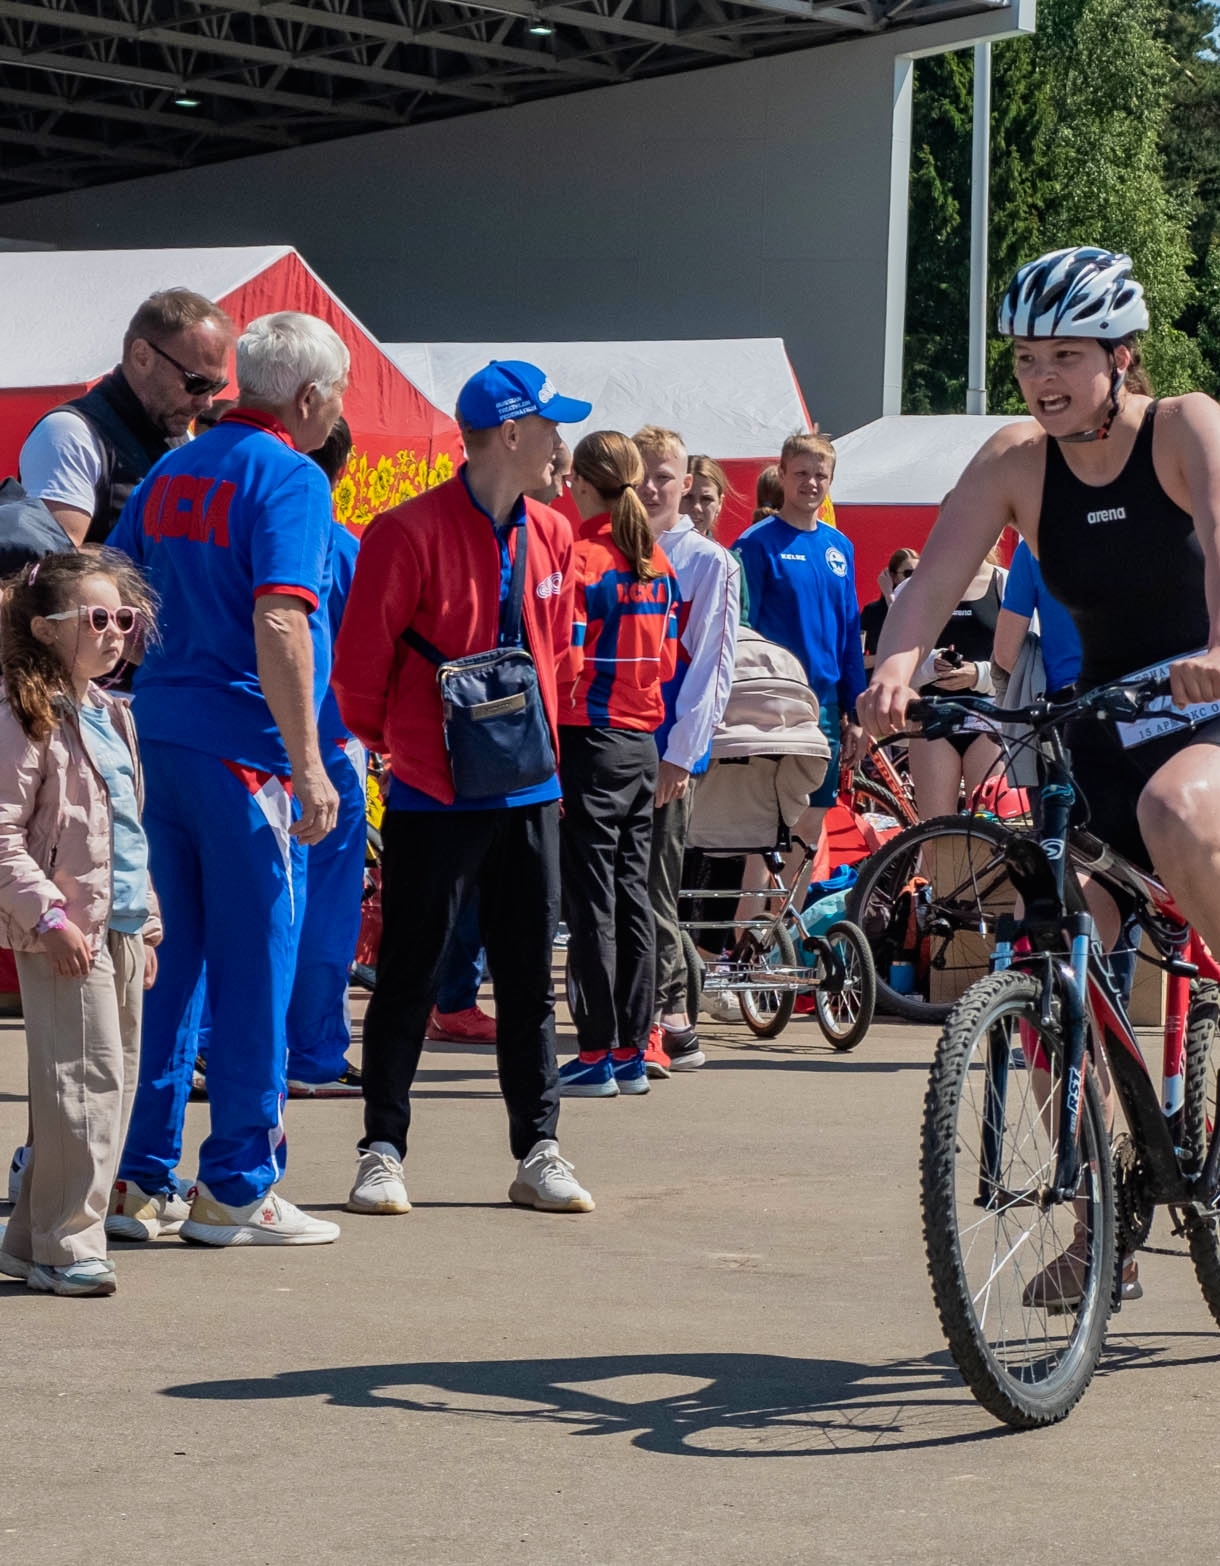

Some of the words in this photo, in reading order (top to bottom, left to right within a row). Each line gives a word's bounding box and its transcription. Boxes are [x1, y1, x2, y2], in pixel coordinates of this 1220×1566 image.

[143, 474, 237, 548] ЦСКА
[1087, 507, 1126, 524] arena
[1138, 728, 1152, 739] 15
[1067, 1066, 1082, 1115] RST
